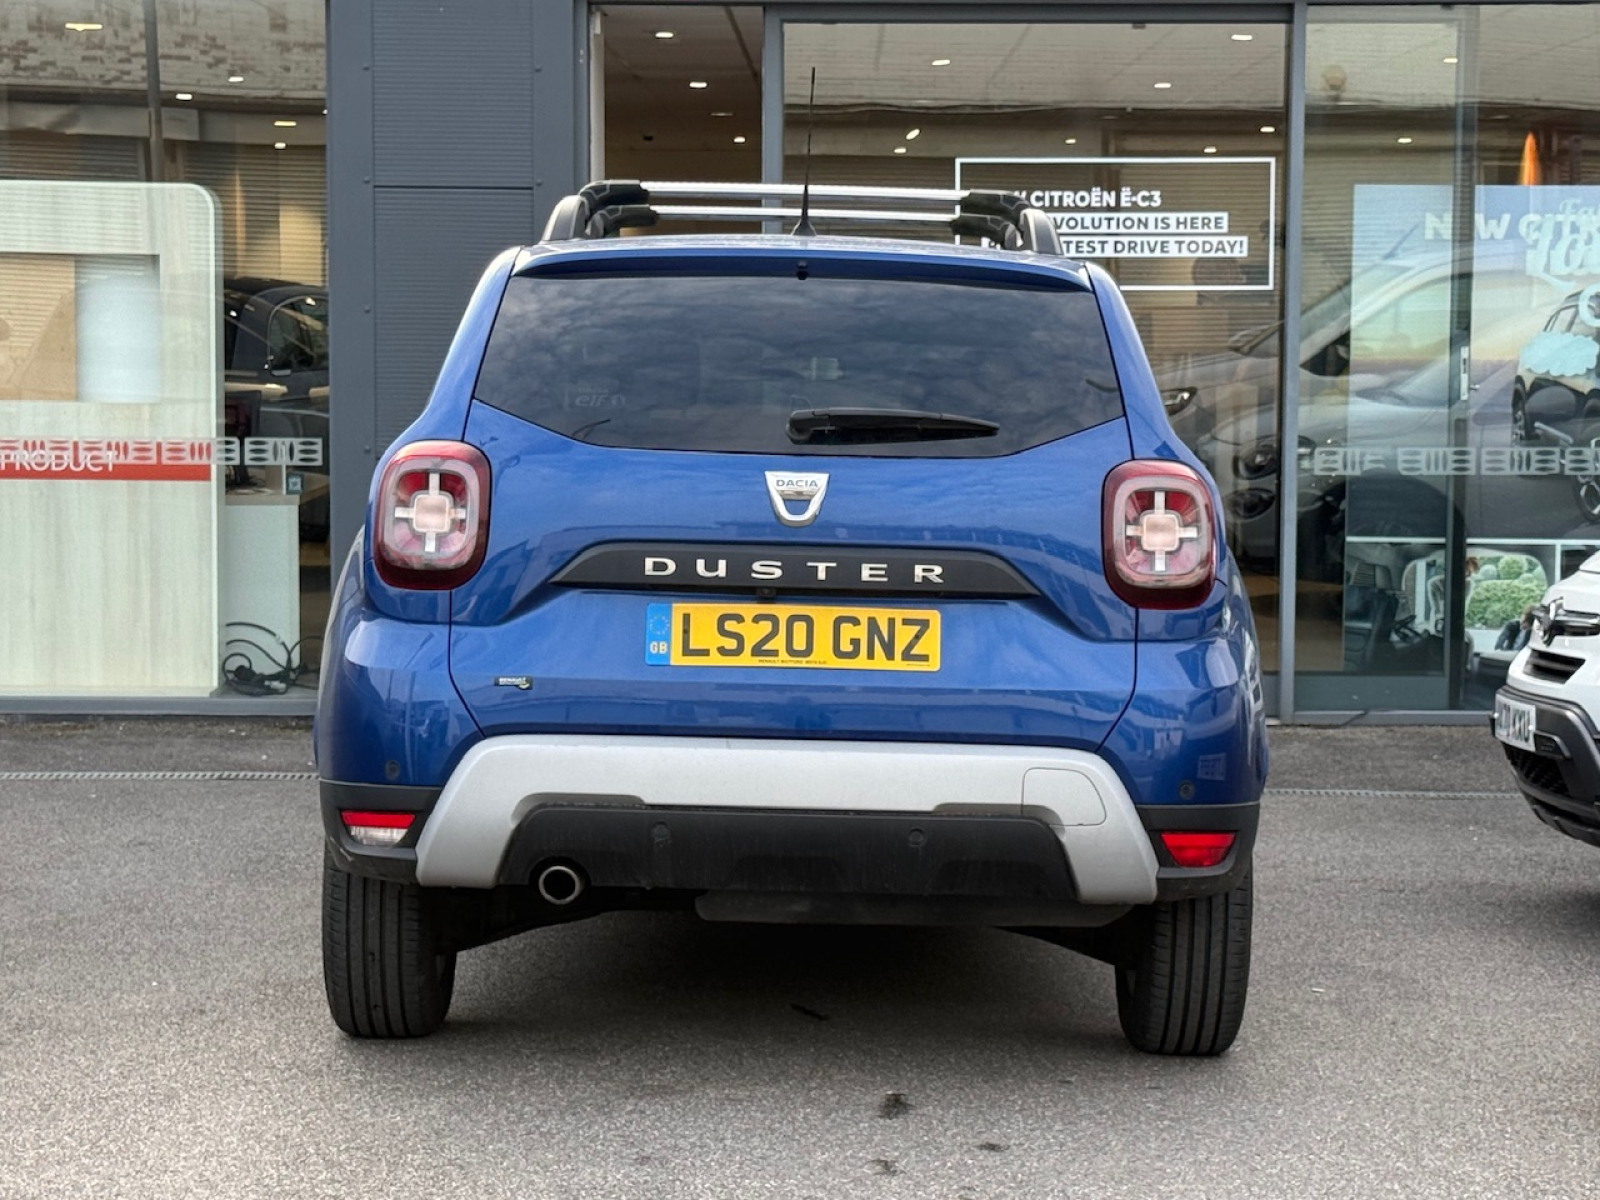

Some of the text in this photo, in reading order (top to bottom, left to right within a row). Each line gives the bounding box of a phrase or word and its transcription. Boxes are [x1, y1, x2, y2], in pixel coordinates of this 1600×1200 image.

[1030, 186, 1116, 208] CITROËN
[1053, 215, 1224, 231] VOLUTION IS HERE
[1424, 212, 1511, 240] NW
[1063, 240, 1244, 255] TEST DRIVE TODAY!
[0, 450, 118, 472] PRODUCT
[776, 479, 818, 487] DACIA
[644, 556, 945, 584] DUSTER
[649, 641, 668, 655] GB
[681, 612, 931, 663] LS20 GNZ
